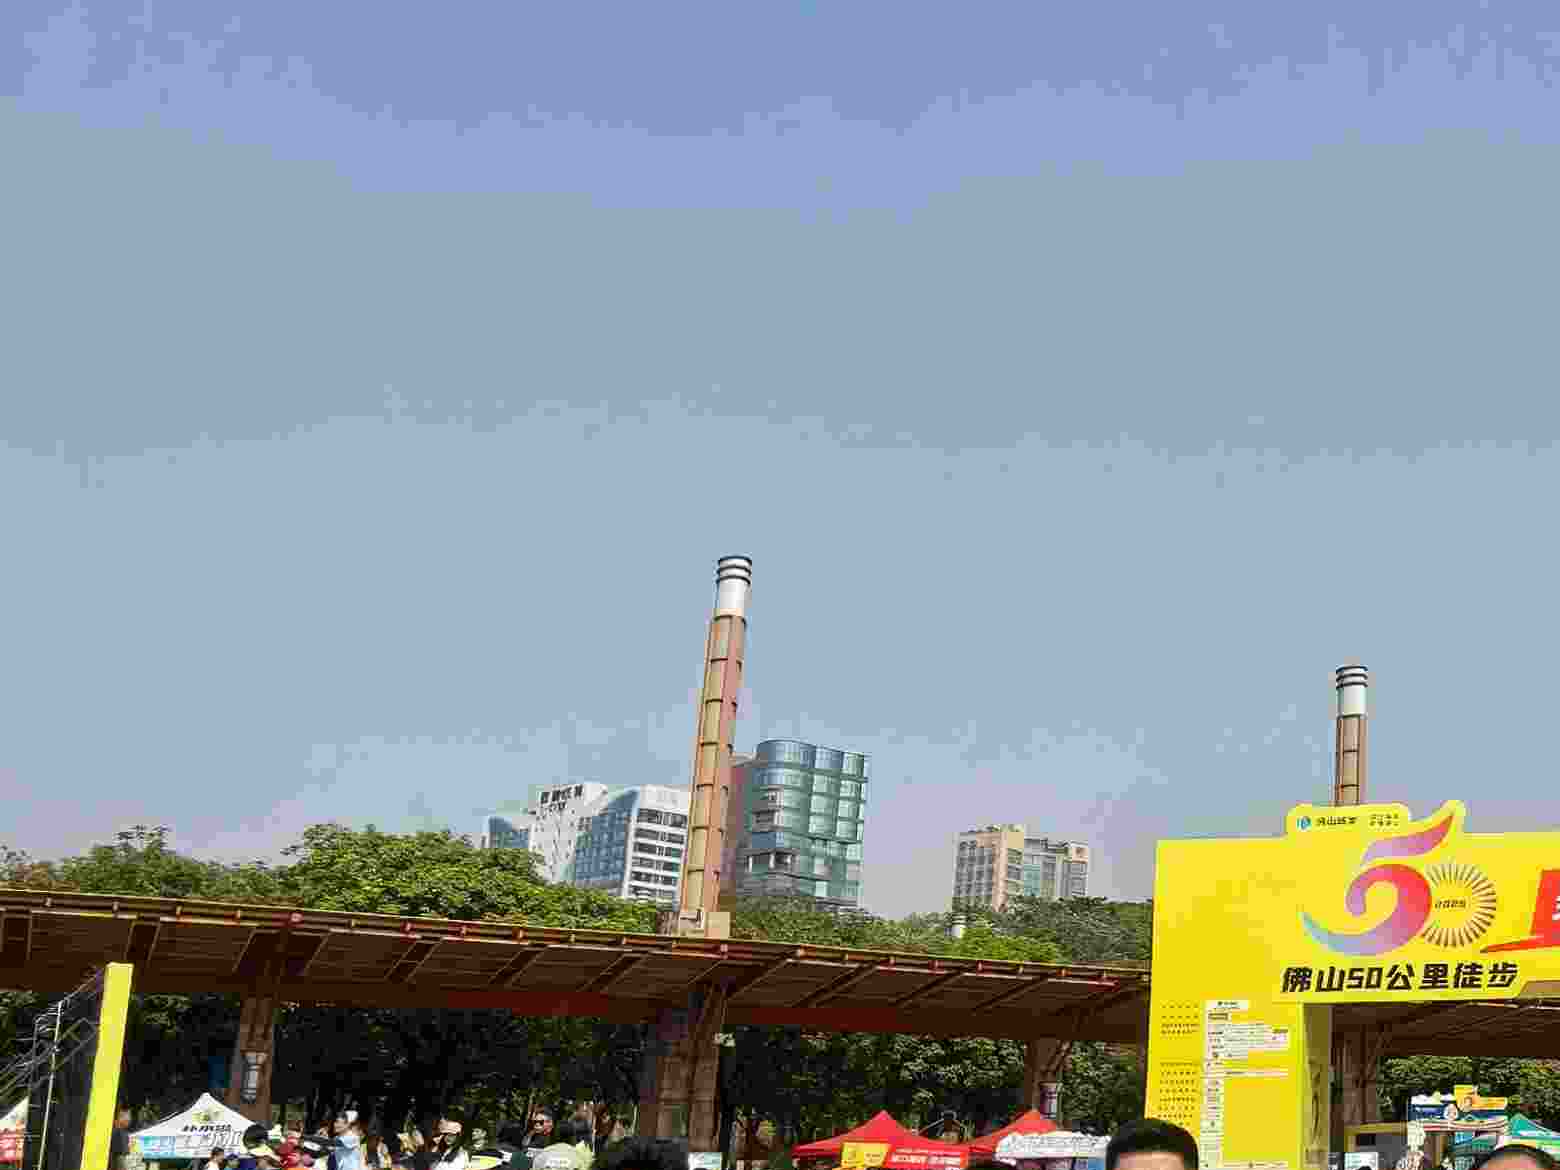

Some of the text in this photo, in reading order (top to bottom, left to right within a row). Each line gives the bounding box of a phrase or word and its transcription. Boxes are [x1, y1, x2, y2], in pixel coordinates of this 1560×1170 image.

[1282, 961, 1519, 993] 佛山50公里徒步
